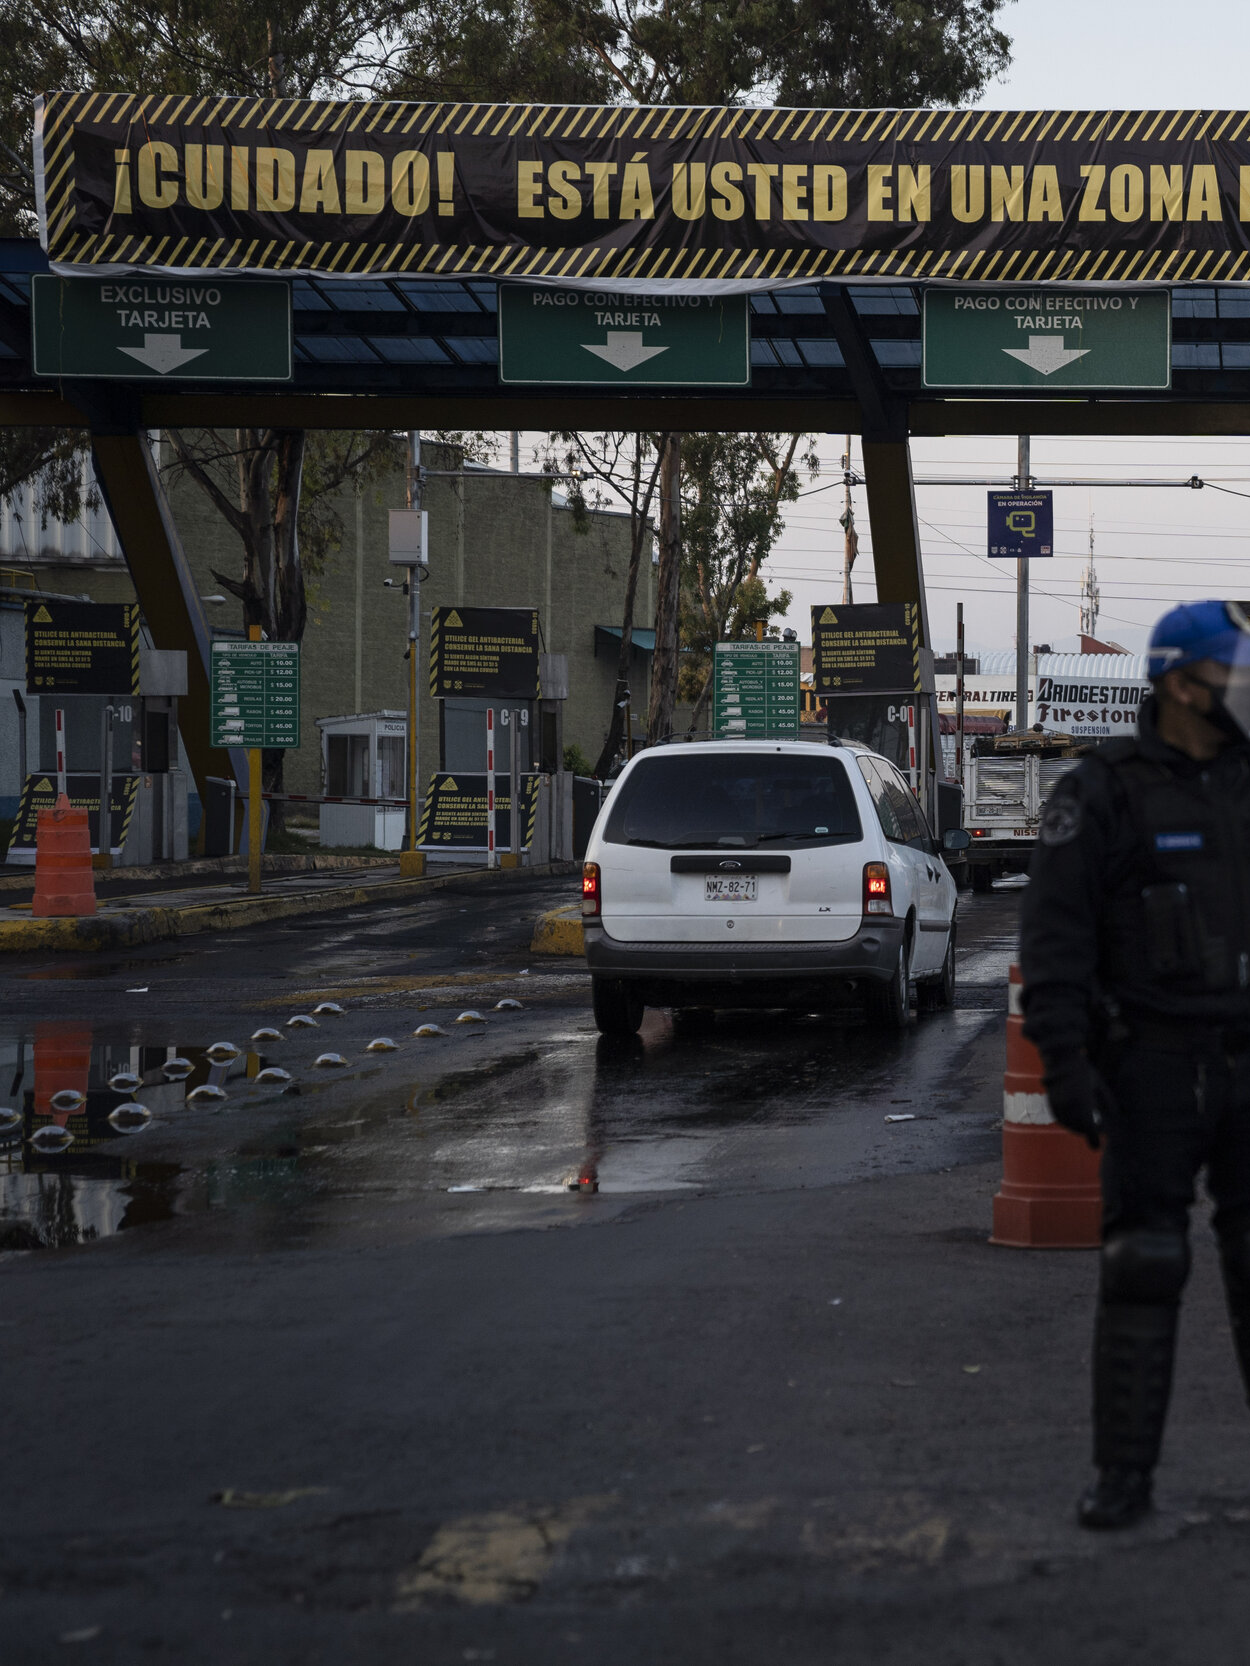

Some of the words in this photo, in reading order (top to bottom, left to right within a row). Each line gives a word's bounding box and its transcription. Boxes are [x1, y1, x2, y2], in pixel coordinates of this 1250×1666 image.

[114, 140, 455, 217] ¡CUIDADO!
[518, 160, 654, 220] ESTÁ
[672, 162, 847, 222] USTED
[868, 164, 931, 222] EN
[951, 164, 1064, 223] UNA
[1079, 164, 1222, 223] ZONA
[101, 285, 222, 305] EXCLUSIVO
[533, 292, 578, 306] PAGO
[584, 292, 620, 306] CON
[624, 293, 701, 308] EFECTIVO
[706, 295, 715, 307] Y
[955, 297, 1000, 310] PAGO
[1005, 297, 1042, 311] CON
[1046, 297, 1122, 310] EFECTIVO
[1129, 297, 1139, 309] Y
[117, 310, 210, 328] TARJETA
[595, 312, 661, 326] TARJETA
[1014, 316, 1082, 328] TARJETA
[1036, 678, 1150, 705] BRIDGESTONE
[501, 708, 529, 726] C-9
[887, 705, 908, 722] C-0
[1037, 703, 1138, 724] Fireston
[1071, 726, 1110, 735] SUSPENSION
[707, 881, 756, 894] NMZ-82-71
